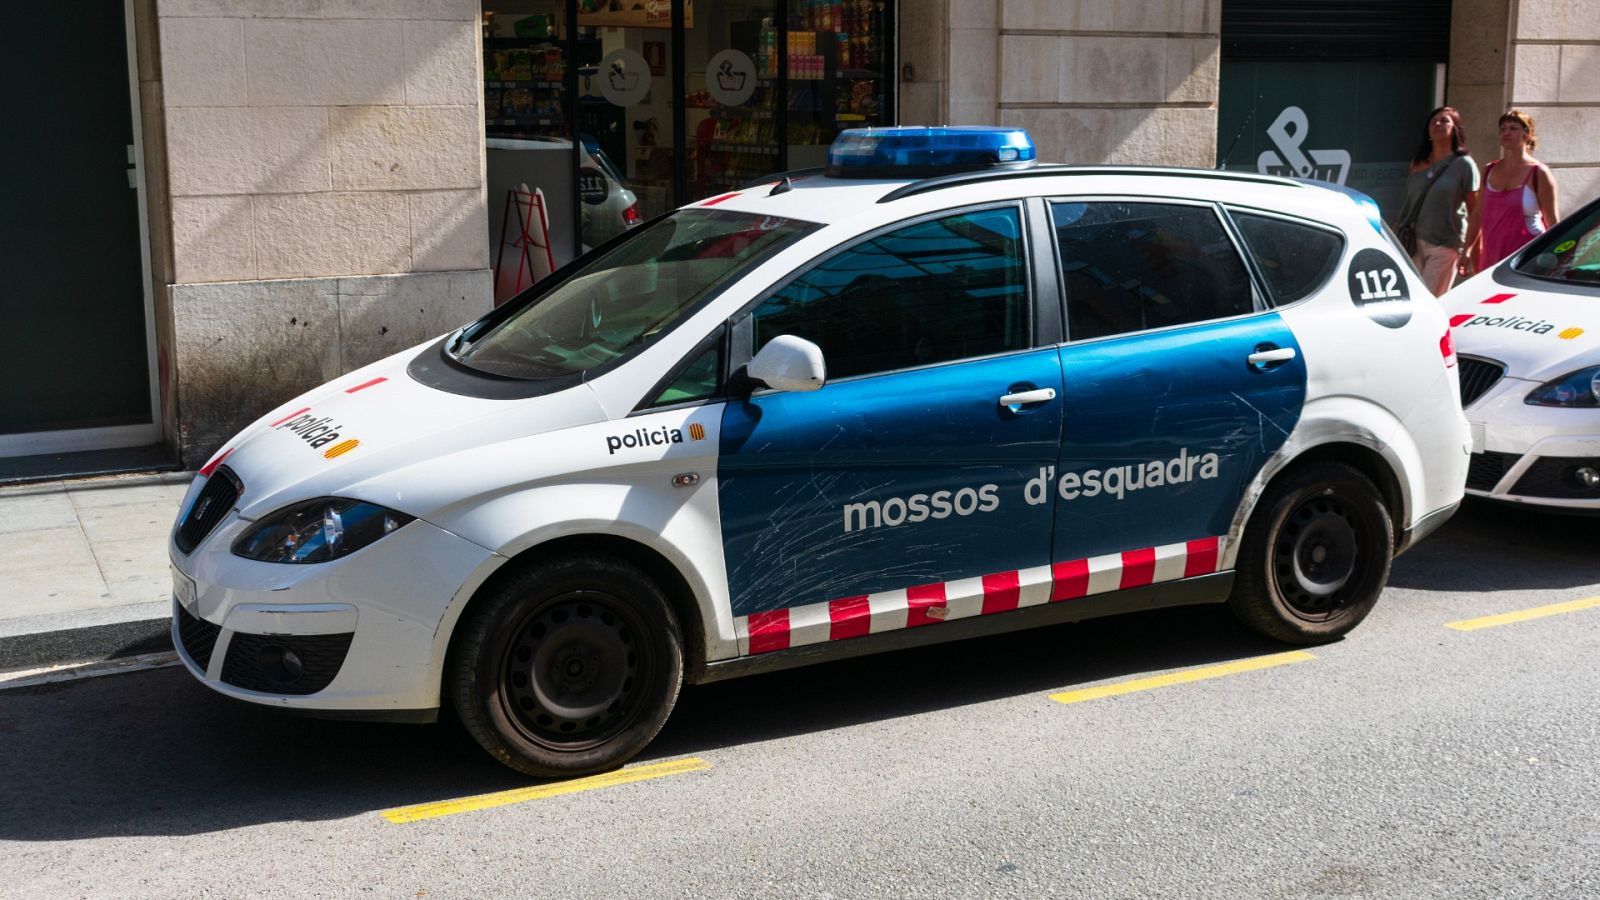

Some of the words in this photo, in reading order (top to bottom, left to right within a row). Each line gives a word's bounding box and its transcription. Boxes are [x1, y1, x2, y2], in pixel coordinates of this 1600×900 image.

[1355, 268, 1401, 299] 112
[1463, 315, 1555, 334] policia
[281, 413, 341, 450] policia
[606, 425, 683, 455] policia
[843, 483, 999, 532] mossos
[1024, 447, 1219, 505] d'esquadra
